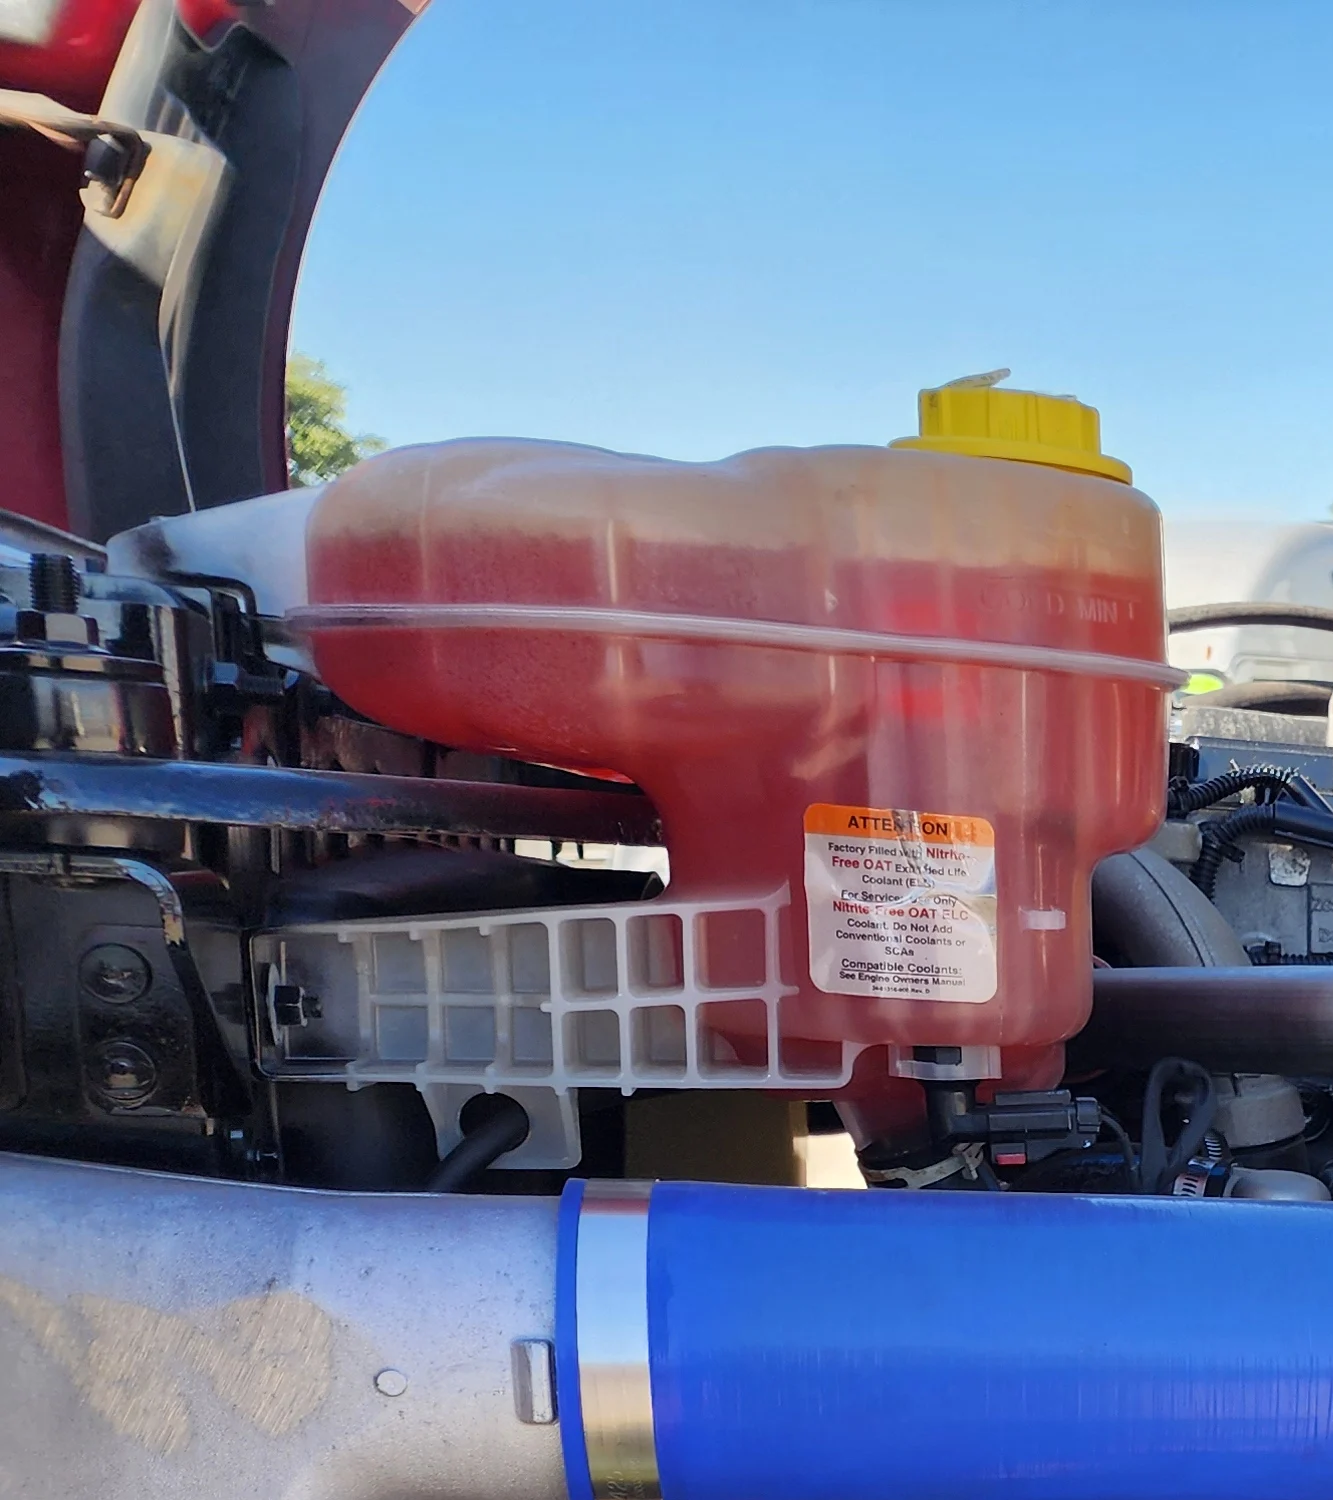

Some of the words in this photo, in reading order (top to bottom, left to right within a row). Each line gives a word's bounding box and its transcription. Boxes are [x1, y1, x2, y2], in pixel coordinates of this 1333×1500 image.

[980, 590, 1064, 615] COD
[1077, 596, 1117, 624] MIN
[848, 815, 948, 835] ATTENTON
[828, 842, 866, 856] Factory
[868, 846, 896, 856] Filled
[832, 856, 860, 869] Free
[864, 858, 892, 871] OAT
[862, 874, 903, 886] Coolant
[841, 889, 858, 900] For
[934, 896, 956, 908] Only
[908, 907, 937, 920] OAT
[942, 908, 968, 920] ELC
[893, 922, 908, 932] Do
[910, 921, 929, 932] Not
[932, 922, 952, 934] Add
[836, 930, 902, 943] Conventional
[906, 936, 952, 946] Coolants
[885, 946, 914, 956] SCAs
[842, 958, 904, 972] Compatible
[908, 963, 962, 976] Coolants:
[840, 972, 856, 980] See
[858, 972, 890, 984] Engine
[893, 976, 929, 985] Owners
[932, 976, 966, 986] Manual
